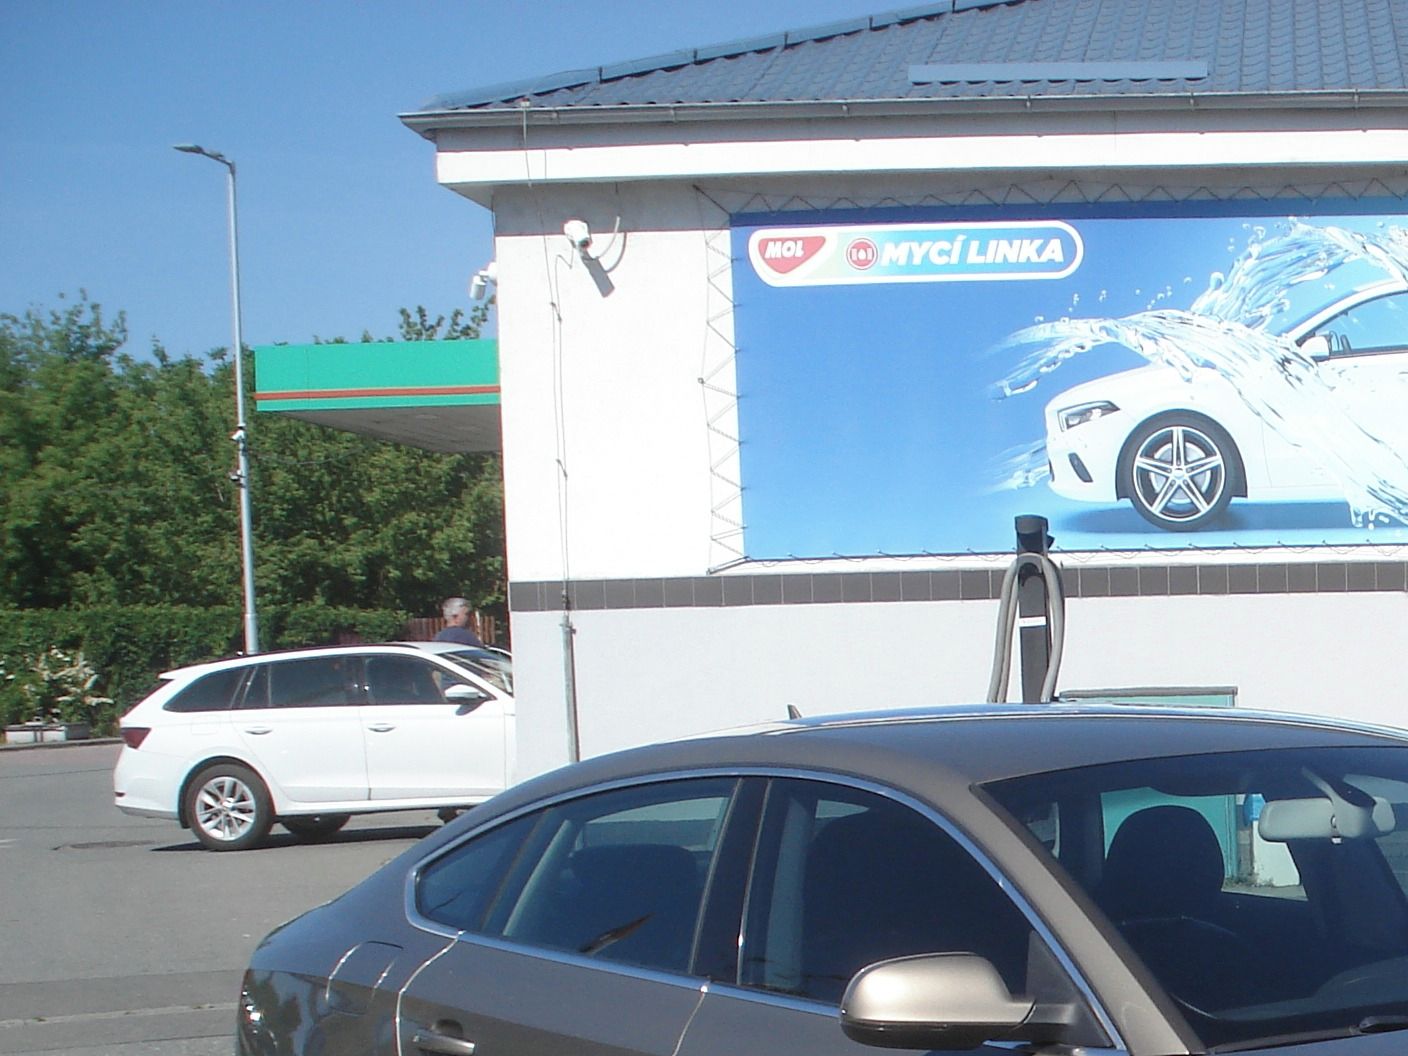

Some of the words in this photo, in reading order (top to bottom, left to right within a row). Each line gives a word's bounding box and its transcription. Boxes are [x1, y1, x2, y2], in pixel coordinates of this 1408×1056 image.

[764, 239, 805, 258] MOL
[881, 235, 967, 266] MYCÍ
[967, 238, 1064, 264] LINKA
